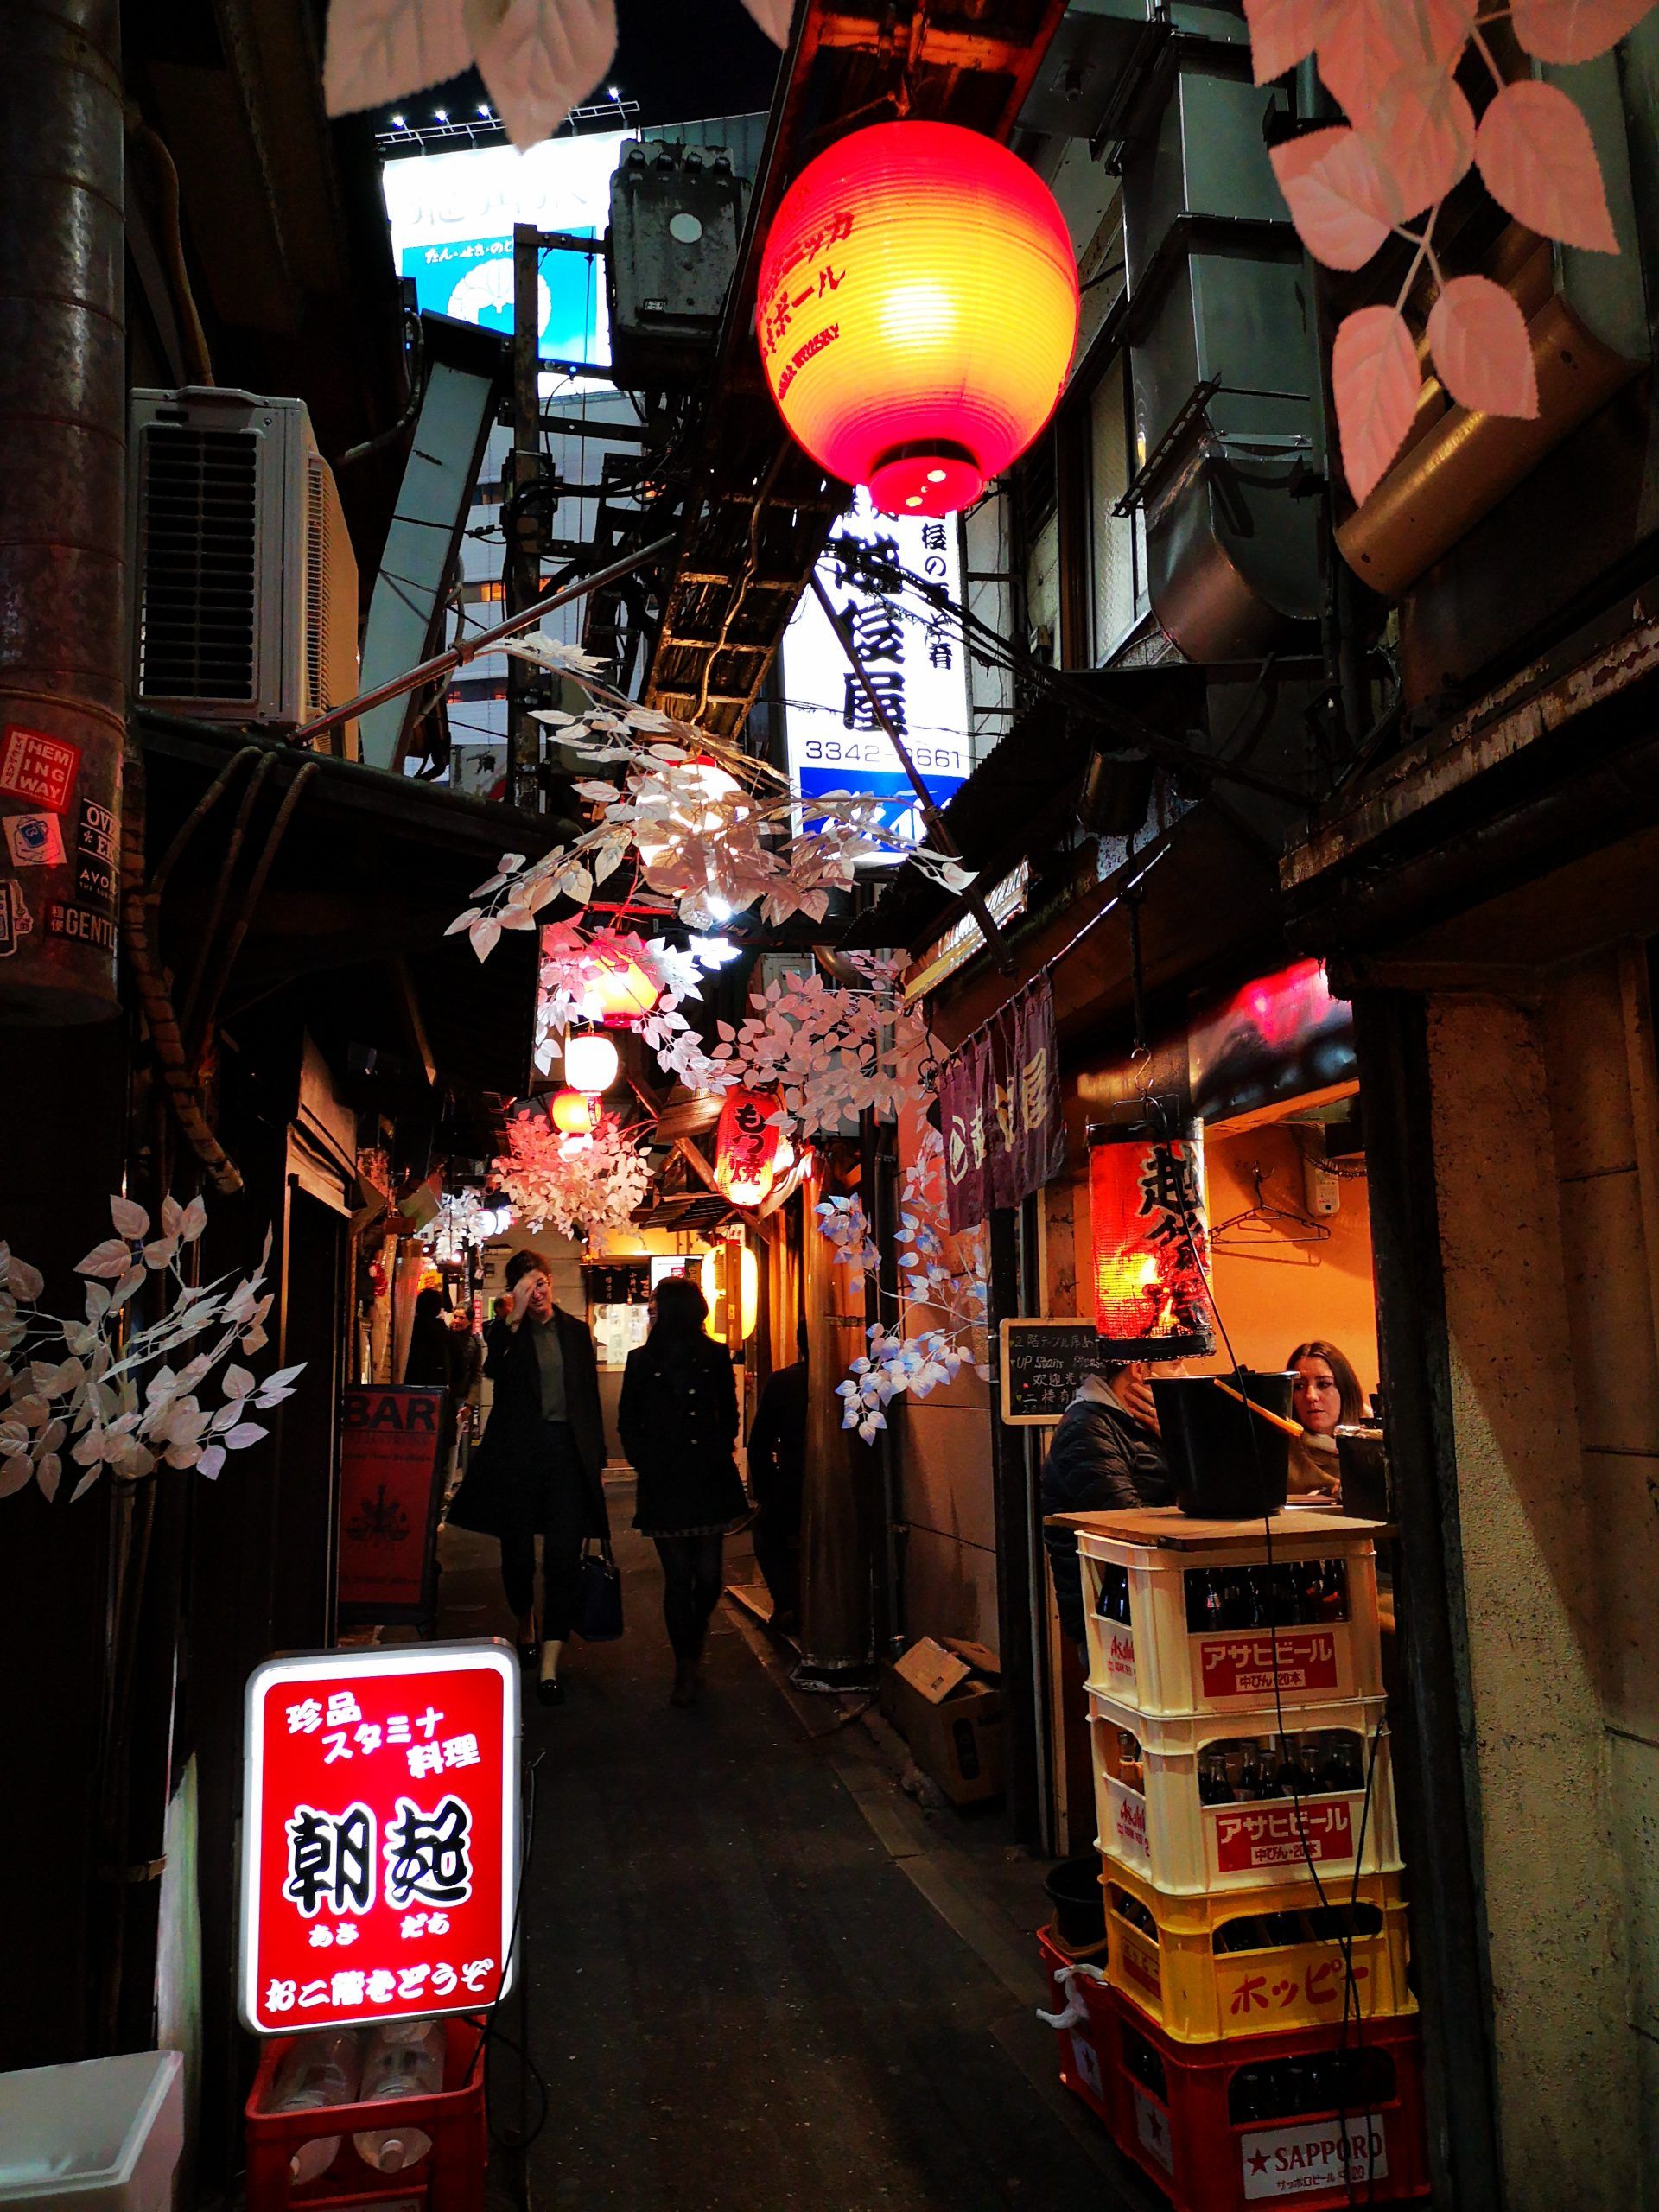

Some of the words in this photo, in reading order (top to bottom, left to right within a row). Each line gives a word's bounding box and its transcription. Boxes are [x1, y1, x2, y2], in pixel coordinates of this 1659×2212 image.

[23, 759, 66, 783] ING
[28, 741, 70, 766] HEM
[20, 775, 62, 801] WAY
[729, 1103, 767, 1186] もつ焼
[1016, 1356, 1032, 1370] UP
[341, 1395, 436, 1431] BAR
[1204, 1638, 1333, 1671] アサヒビール
[285, 1690, 362, 1735] 珍品
[321, 1707, 445, 1764] スタミナ
[406, 1733, 481, 1779] 料理
[1218, 1808, 1349, 1845] アサヒビール
[308, 1922, 359, 1948] あさ
[400, 1912, 451, 1940] だち
[1230, 1958, 1370, 2016] ホッピー
[1274, 2133, 1382, 2172] SAPPORO
